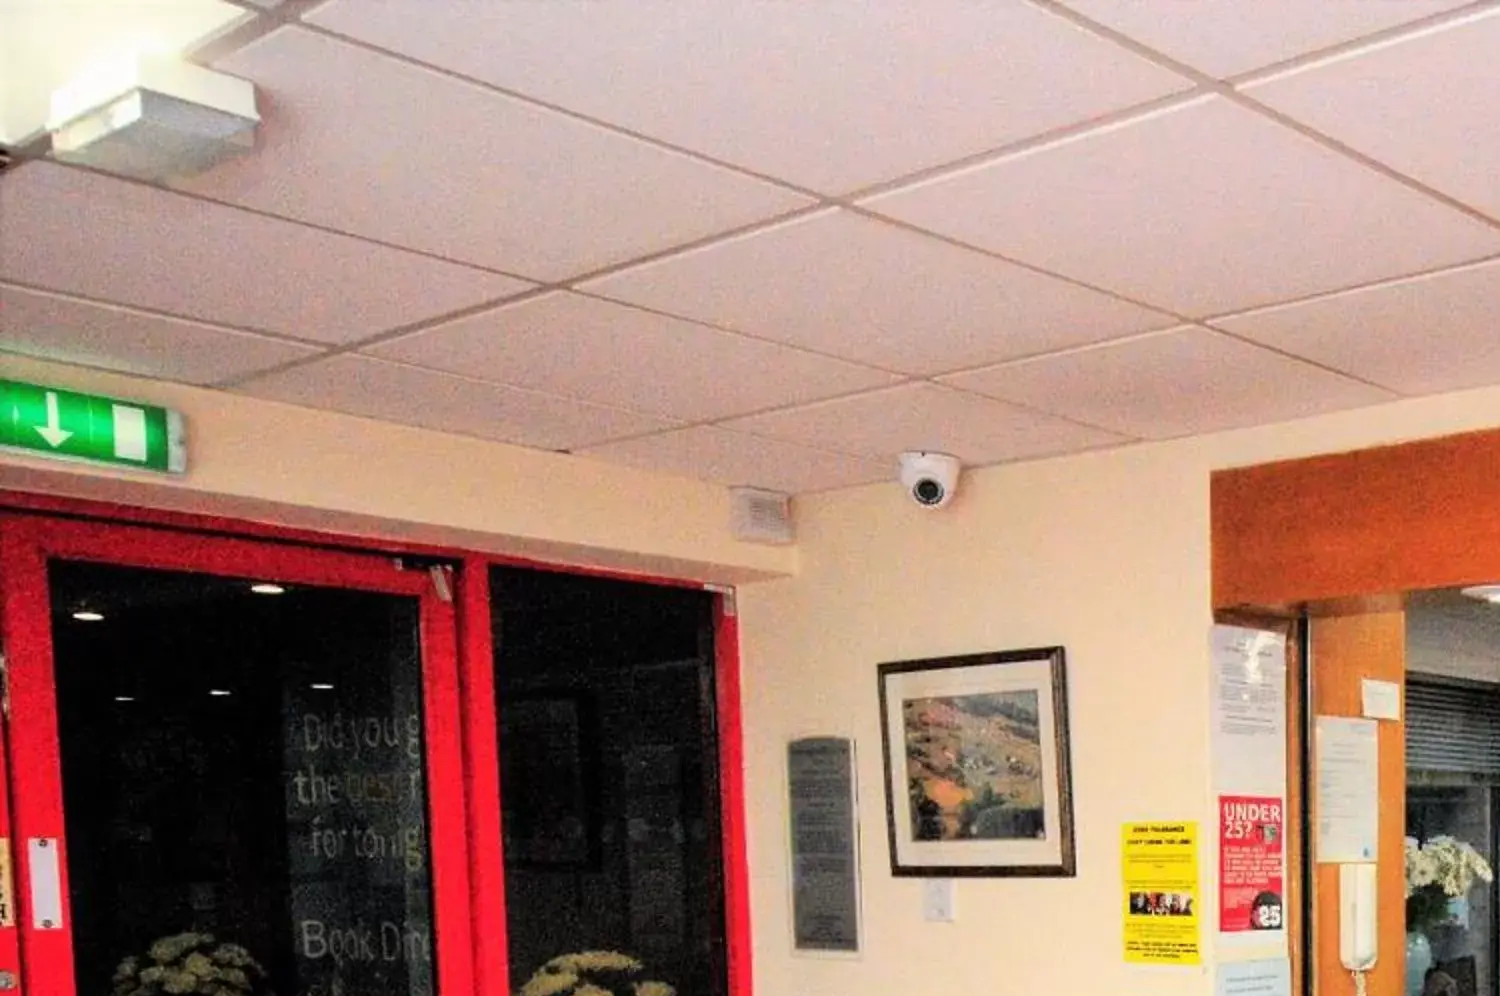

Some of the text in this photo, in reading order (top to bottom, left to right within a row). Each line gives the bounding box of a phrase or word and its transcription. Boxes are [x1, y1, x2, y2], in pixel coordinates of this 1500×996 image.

[304, 712, 344, 752] Did
[350, 716, 400, 760] you
[294, 764, 340, 804] the
[1223, 803, 1281, 823] UNDER
[1224, 821, 1253, 839] 25?
[311, 816, 423, 872] for tonig
[1258, 904, 1281, 926] 25
[302, 918, 375, 961] Book
